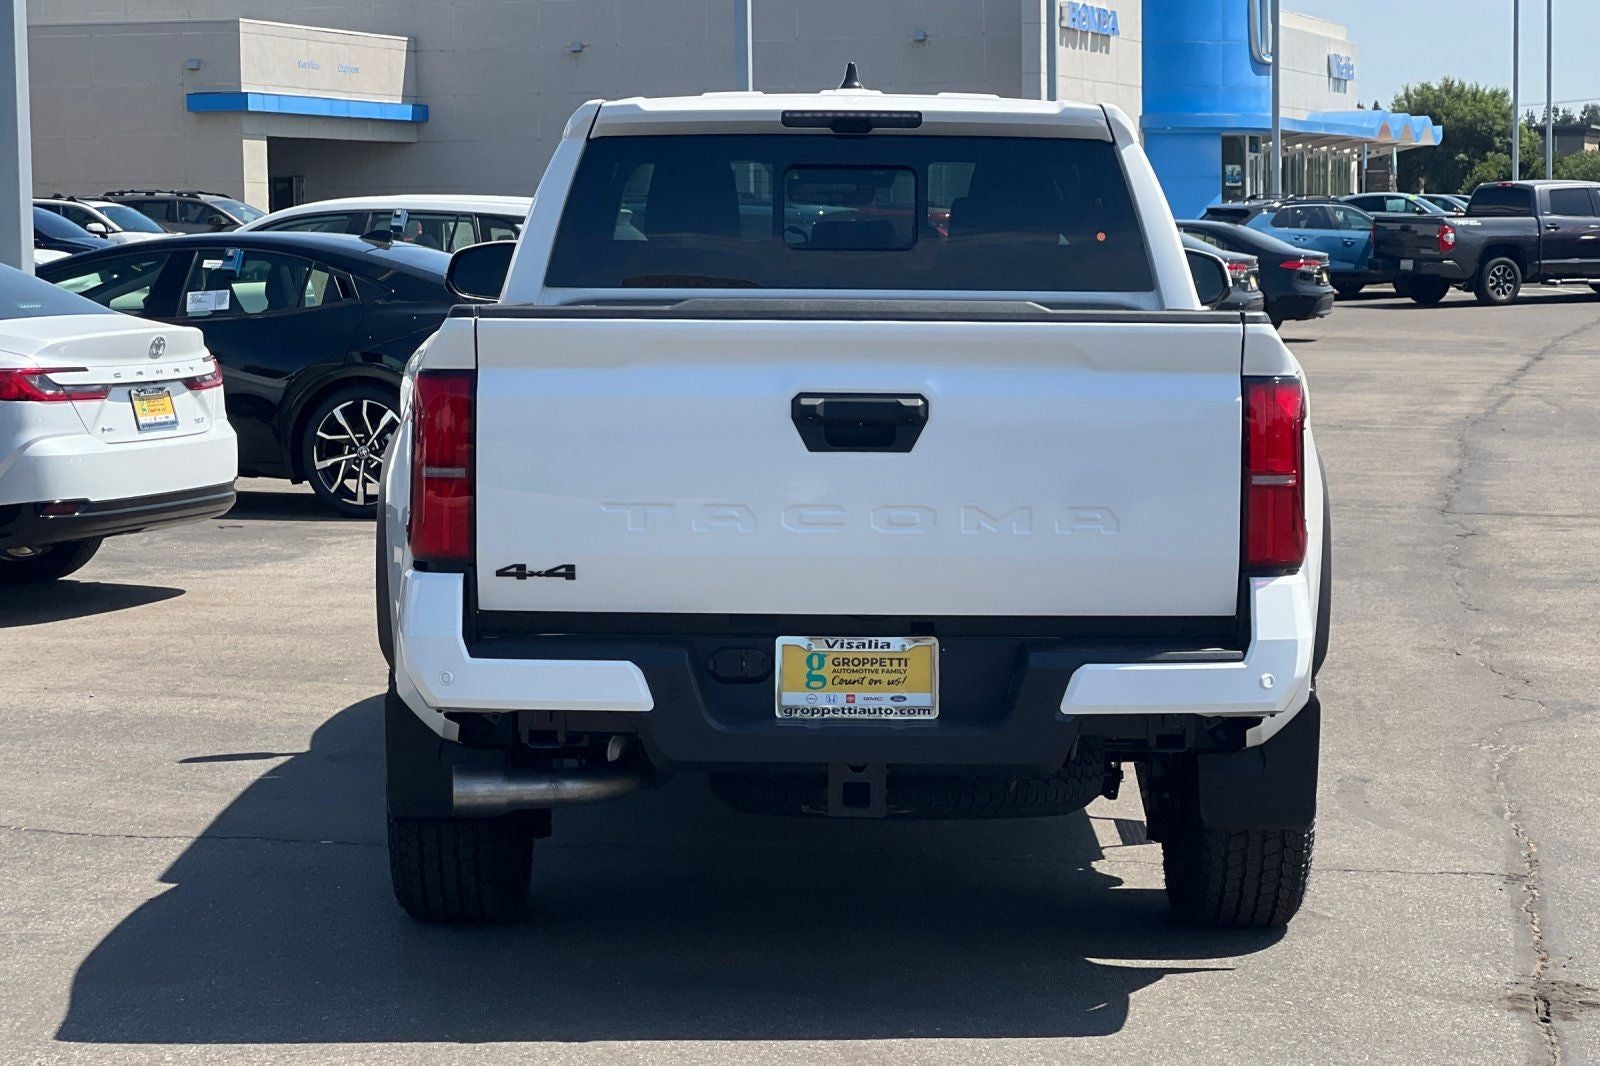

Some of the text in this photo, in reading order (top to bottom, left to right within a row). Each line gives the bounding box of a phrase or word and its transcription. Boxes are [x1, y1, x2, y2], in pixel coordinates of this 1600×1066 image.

[1065, 2, 1119, 36] HONDA
[600, 502, 1121, 535] TACOMA
[496, 563, 576, 580] 4x4
[824, 639, 891, 650] Visalia
[831, 657, 908, 668] GROPPETTI
[831, 675, 908, 686] Count on us!
[783, 706, 931, 717] groppettiauto.com
